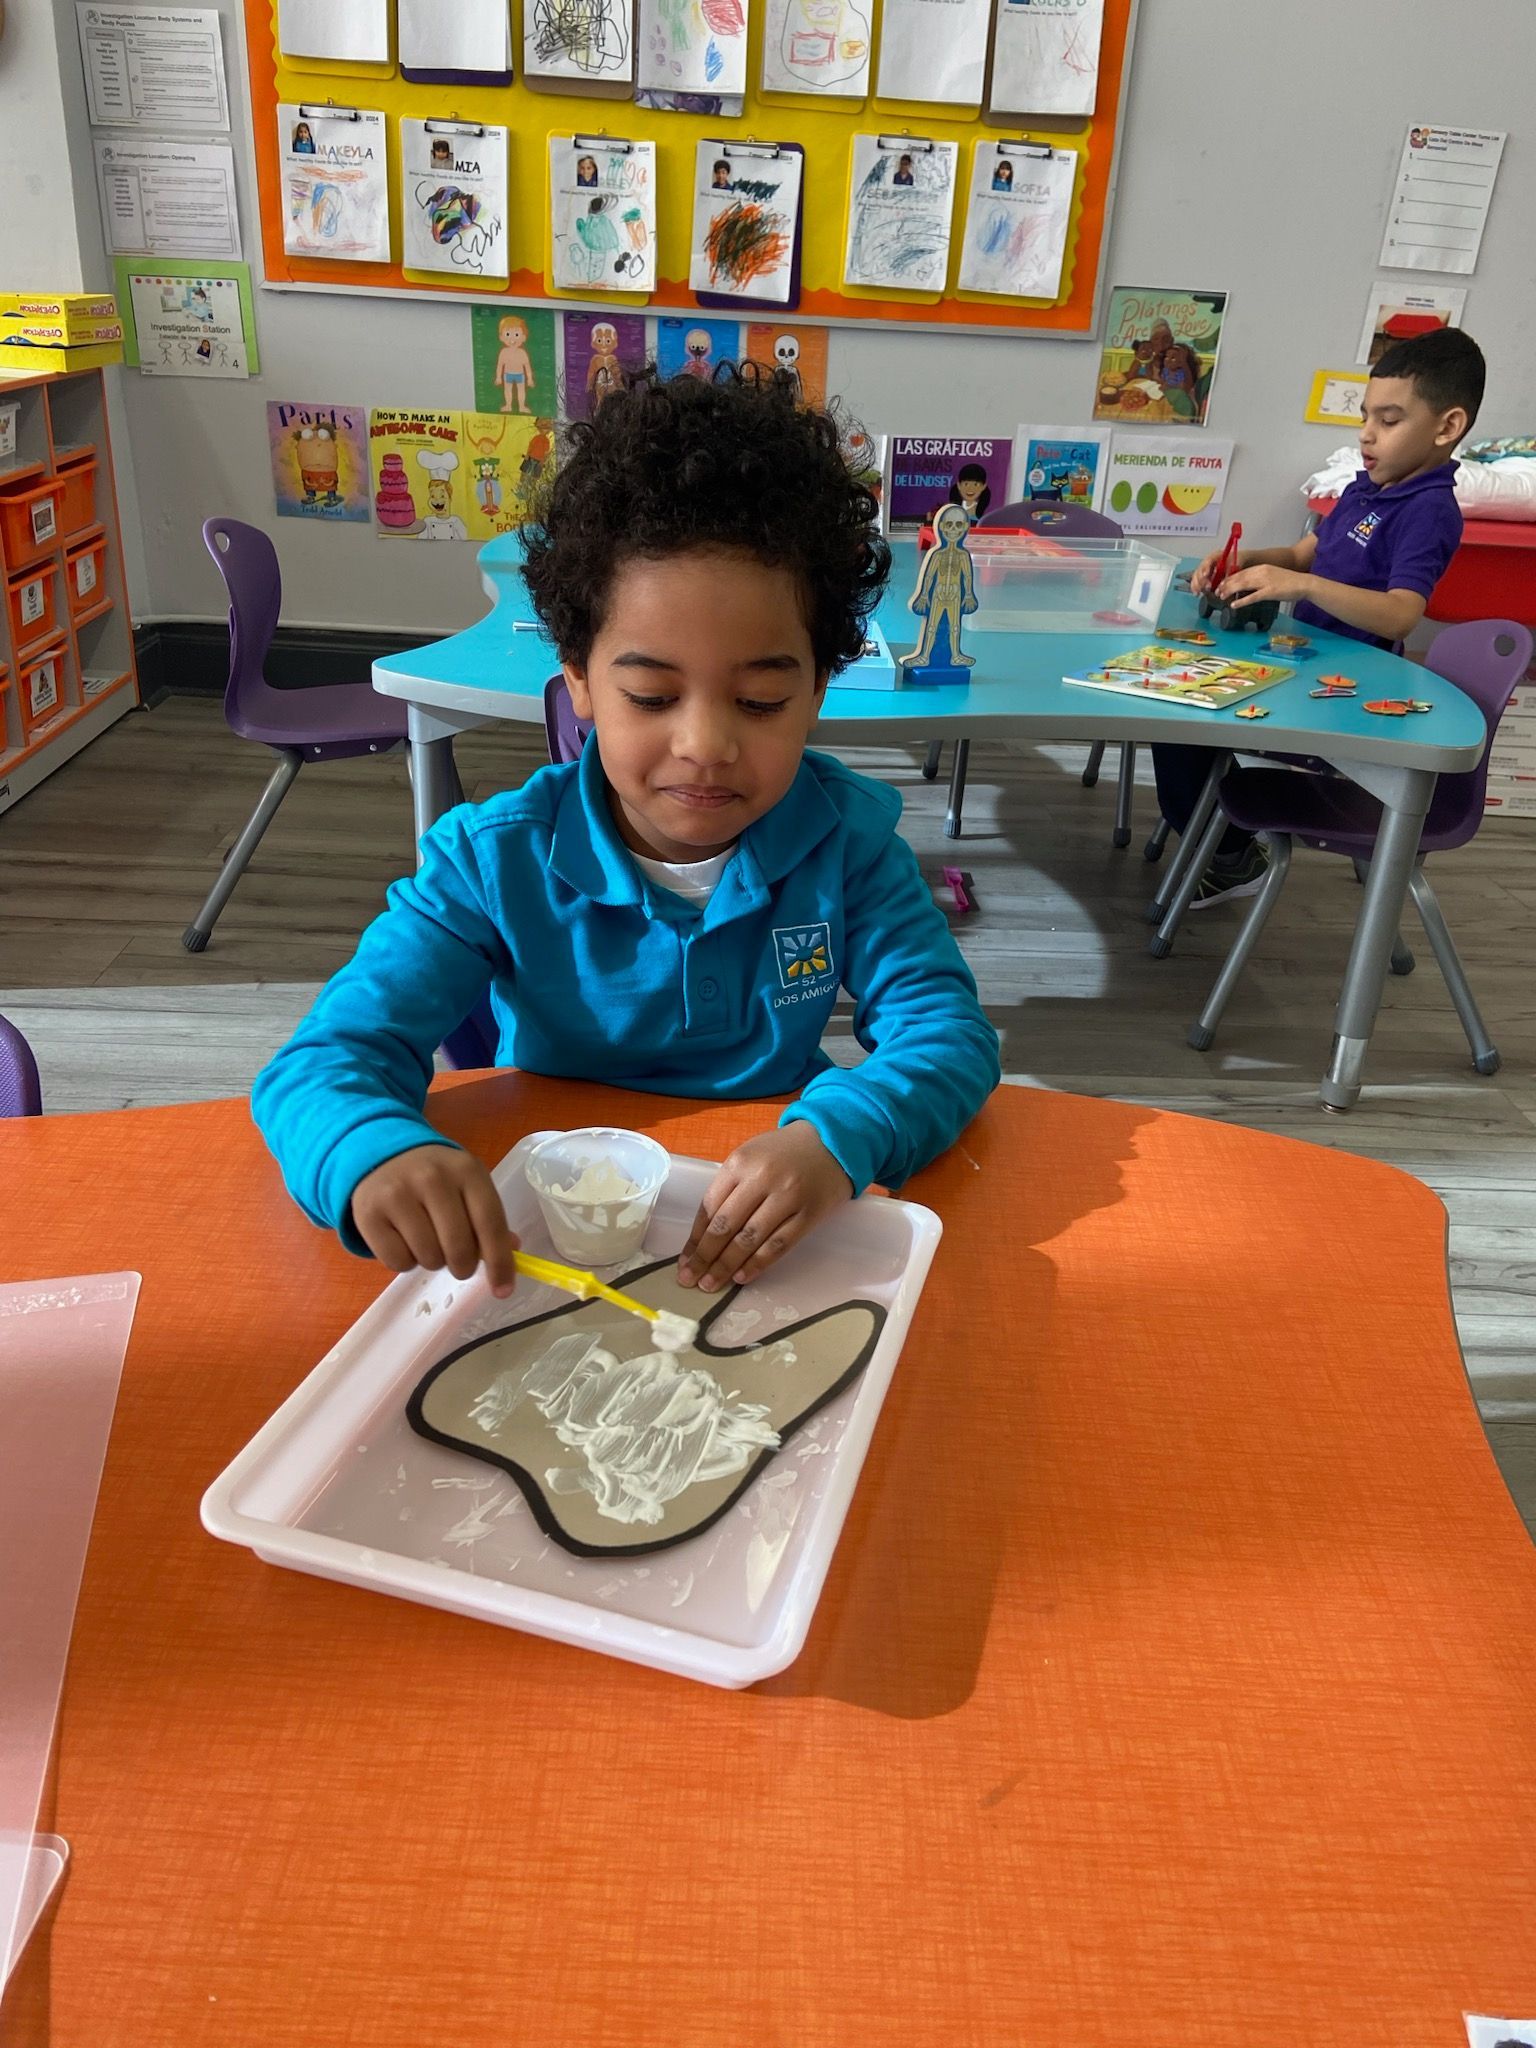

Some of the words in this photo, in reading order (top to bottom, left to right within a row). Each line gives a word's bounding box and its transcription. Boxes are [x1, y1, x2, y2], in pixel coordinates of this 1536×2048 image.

[317, 144, 374, 160] MAKEYLA
[455, 160, 481, 174] MIA
[1014, 182, 1050, 196] SOFIA
[150, 322, 201, 333] Investigation
[202, 324, 231, 334] Station
[1174, 315, 1212, 337] Love
[232, 359, 239, 369] 4
[278, 404, 353, 430] Parts
[376, 411, 396, 420] HOW
[399, 412, 409, 421] TO
[411, 413, 435, 423] MAKE
[437, 415, 450, 424] AN
[370, 422, 427, 438] AWESOME
[428, 425, 459, 442] CAKE
[896, 439, 923, 456] LAS
[925, 438, 993, 457] GRÁFICAS
[1070, 448, 1091, 460] Cat
[1113, 454, 1169, 467] MERIENDA
[1171, 456, 1185, 468] DE
[1188, 457, 1222, 469] FRUTA
[895, 474, 907, 486] DE
[908, 474, 953, 487] LINDSEY
[774, 993, 799, 1009] DOS
